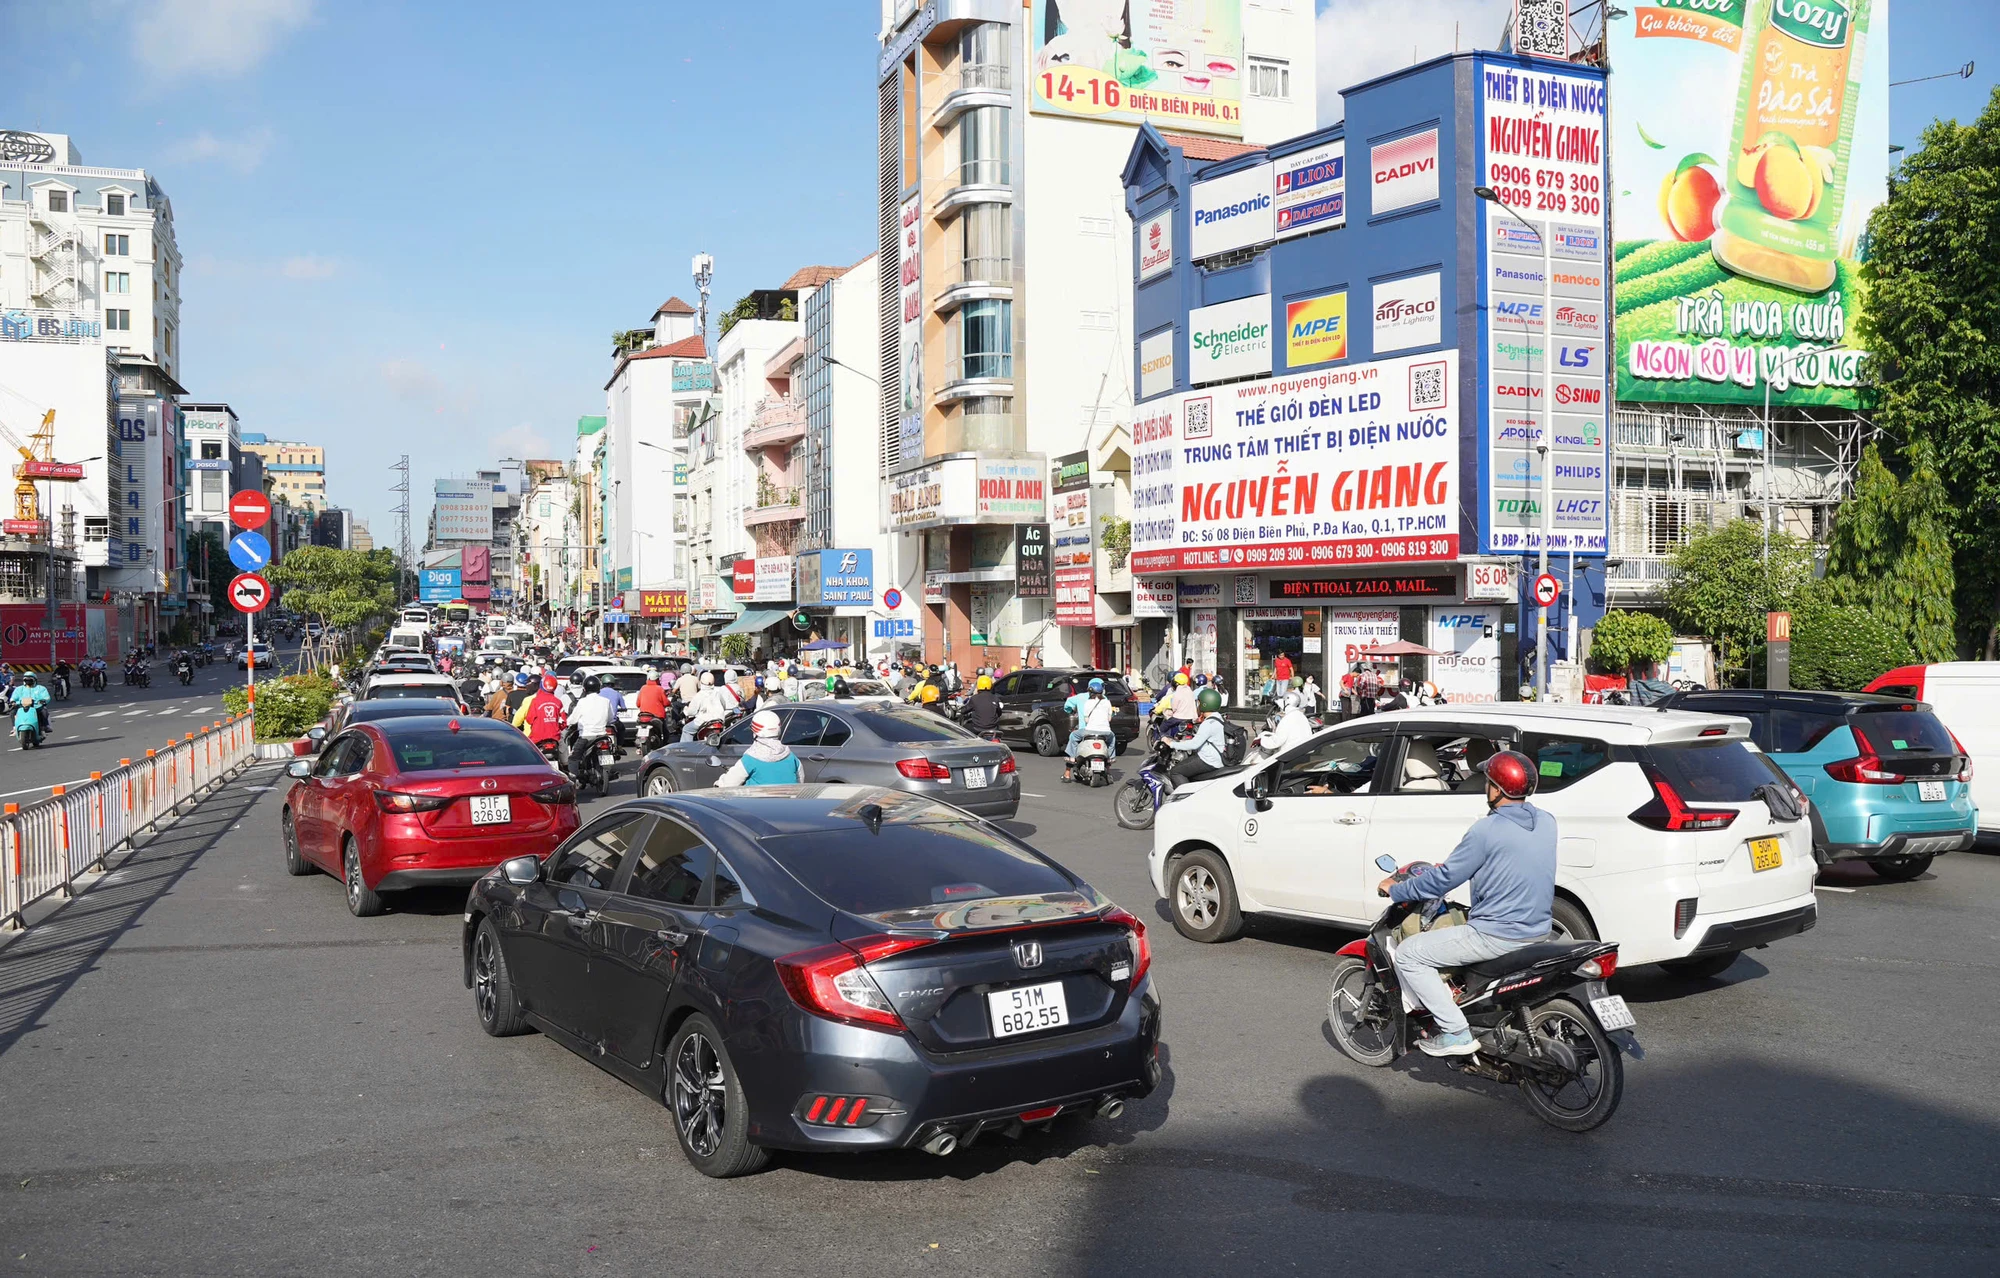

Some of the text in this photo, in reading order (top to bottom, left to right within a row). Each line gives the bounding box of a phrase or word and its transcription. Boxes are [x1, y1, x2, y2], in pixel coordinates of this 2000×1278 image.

[1776, 0, 1842, 39] Cozy
[1641, 14, 1736, 43] Gu không đổi
[1790, 63, 1818, 81] Trà
[1042, 72, 1239, 120] 14-16 ĐIỆN BIÊN PHỦ, Q.1
[1486, 68, 1604, 115] THIẾT BỊ ĐIỆN NƯỚC
[1757, 80, 1835, 115] Đào Sả
[1490, 111, 1599, 164] NGUYỄN GIANG
[1298, 162, 1336, 186] LION
[1375, 157, 1434, 184] CADIVI
[1491, 163, 1599, 193] 0906 679 300
[1194, 194, 1270, 227] Panasonic
[1293, 199, 1342, 222] DAPHACO
[1537, 191, 1566, 212] 209
[1571, 196, 1600, 215] 300
[1496, 267, 1543, 281] Panasonic
[1554, 272, 1600, 287] nanoco
[1376, 300, 1435, 322] anfaco
[1497, 301, 1543, 316] MPE
[1679, 289, 1844, 341] TRÀ HOA QUẢ
[38, 318, 60, 336] QS
[1292, 315, 1341, 339] MPE
[1403, 314, 1435, 326] Lighting
[1193, 321, 1268, 349] Schneider
[1224, 340, 1267, 356] Electric
[1497, 343, 1544, 356] Schneider
[1141, 354, 1172, 376] SENKO
[1559, 347, 1590, 367] LS
[1636, 343, 1690, 376] NGON
[1701, 342, 1727, 376] RÕ
[1735, 346, 1751, 383] VỊ
[1766, 352, 1785, 386] VỊ
[1795, 346, 1819, 381] RÕ
[695, 378, 713, 389] SPA
[1238, 368, 1378, 398] www.nguyengiang.vn
[1497, 386, 1543, 398] CADIVI
[1573, 388, 1600, 404] SINO
[1236, 392, 1381, 427] THẾ GIỚI ĐÈN LED
[120, 418, 145, 442] QS
[1184, 413, 1447, 464] TRUNG TÂM THIẾT BỊ ĐIỆN NƯỚC
[1555, 435, 1601, 446] KINGLED
[1556, 466, 1601, 479] PHILIPS
[980, 476, 1042, 499] HOÀI ANH
[1181, 460, 1448, 522] NGUYỄN GIANG
[917, 484, 941, 509] ANH
[980, 502, 989, 512] 14
[1556, 500, 1601, 513] LHCT
[1026, 526, 1040, 540] ẮC
[1183, 515, 1446, 543] ĐC: Số 08 Điện Biên Phủ, P.Đa Kao, Q.1, TP.HCM
[1502, 533, 1519, 546] ĐBP
[1022, 545, 1044, 556] QUY
[1183, 540, 1448, 565] HOTLINE: 0909 209 300 0906 679 300 0906 819 300
[1022, 558, 1044, 570] HÒA
[1133, 554, 1176, 567] www.nguyengiang.vn
[826, 577, 869, 588] NHA KHOA
[1020, 573, 1047, 586] PHÁT
[1475, 566, 1508, 585] Số 08
[1137, 579, 1174, 590] THẾ GIỚI
[1283, 580, 1438, 596] ĐIỆN THOẠI, ZALO, MAIL...
[644, 590, 671, 606] MẮT
[824, 590, 872, 601] SAINT PAUL
[1137, 592, 1154, 601] ĐÈN
[1246, 609, 1255, 617] LED
[1439, 615, 1485, 628] MPE
[1308, 622, 1315, 633] 8
[1334, 623, 1398, 636] TRUNG TÂM THIẾT
[1438, 656, 1485, 667] anfaco
[480, 797, 500, 809] 51F
[474, 809, 509, 823] 326.92
[1758, 840, 1772, 854] 50H
[1756, 852, 1780, 869] 265.40
[898, 987, 944, 998] CIVIC
[1011, 988, 1045, 1009] 51M
[1002, 1007, 1060, 1033] 682.55
[1603, 1011, 1634, 1028] 513.20
